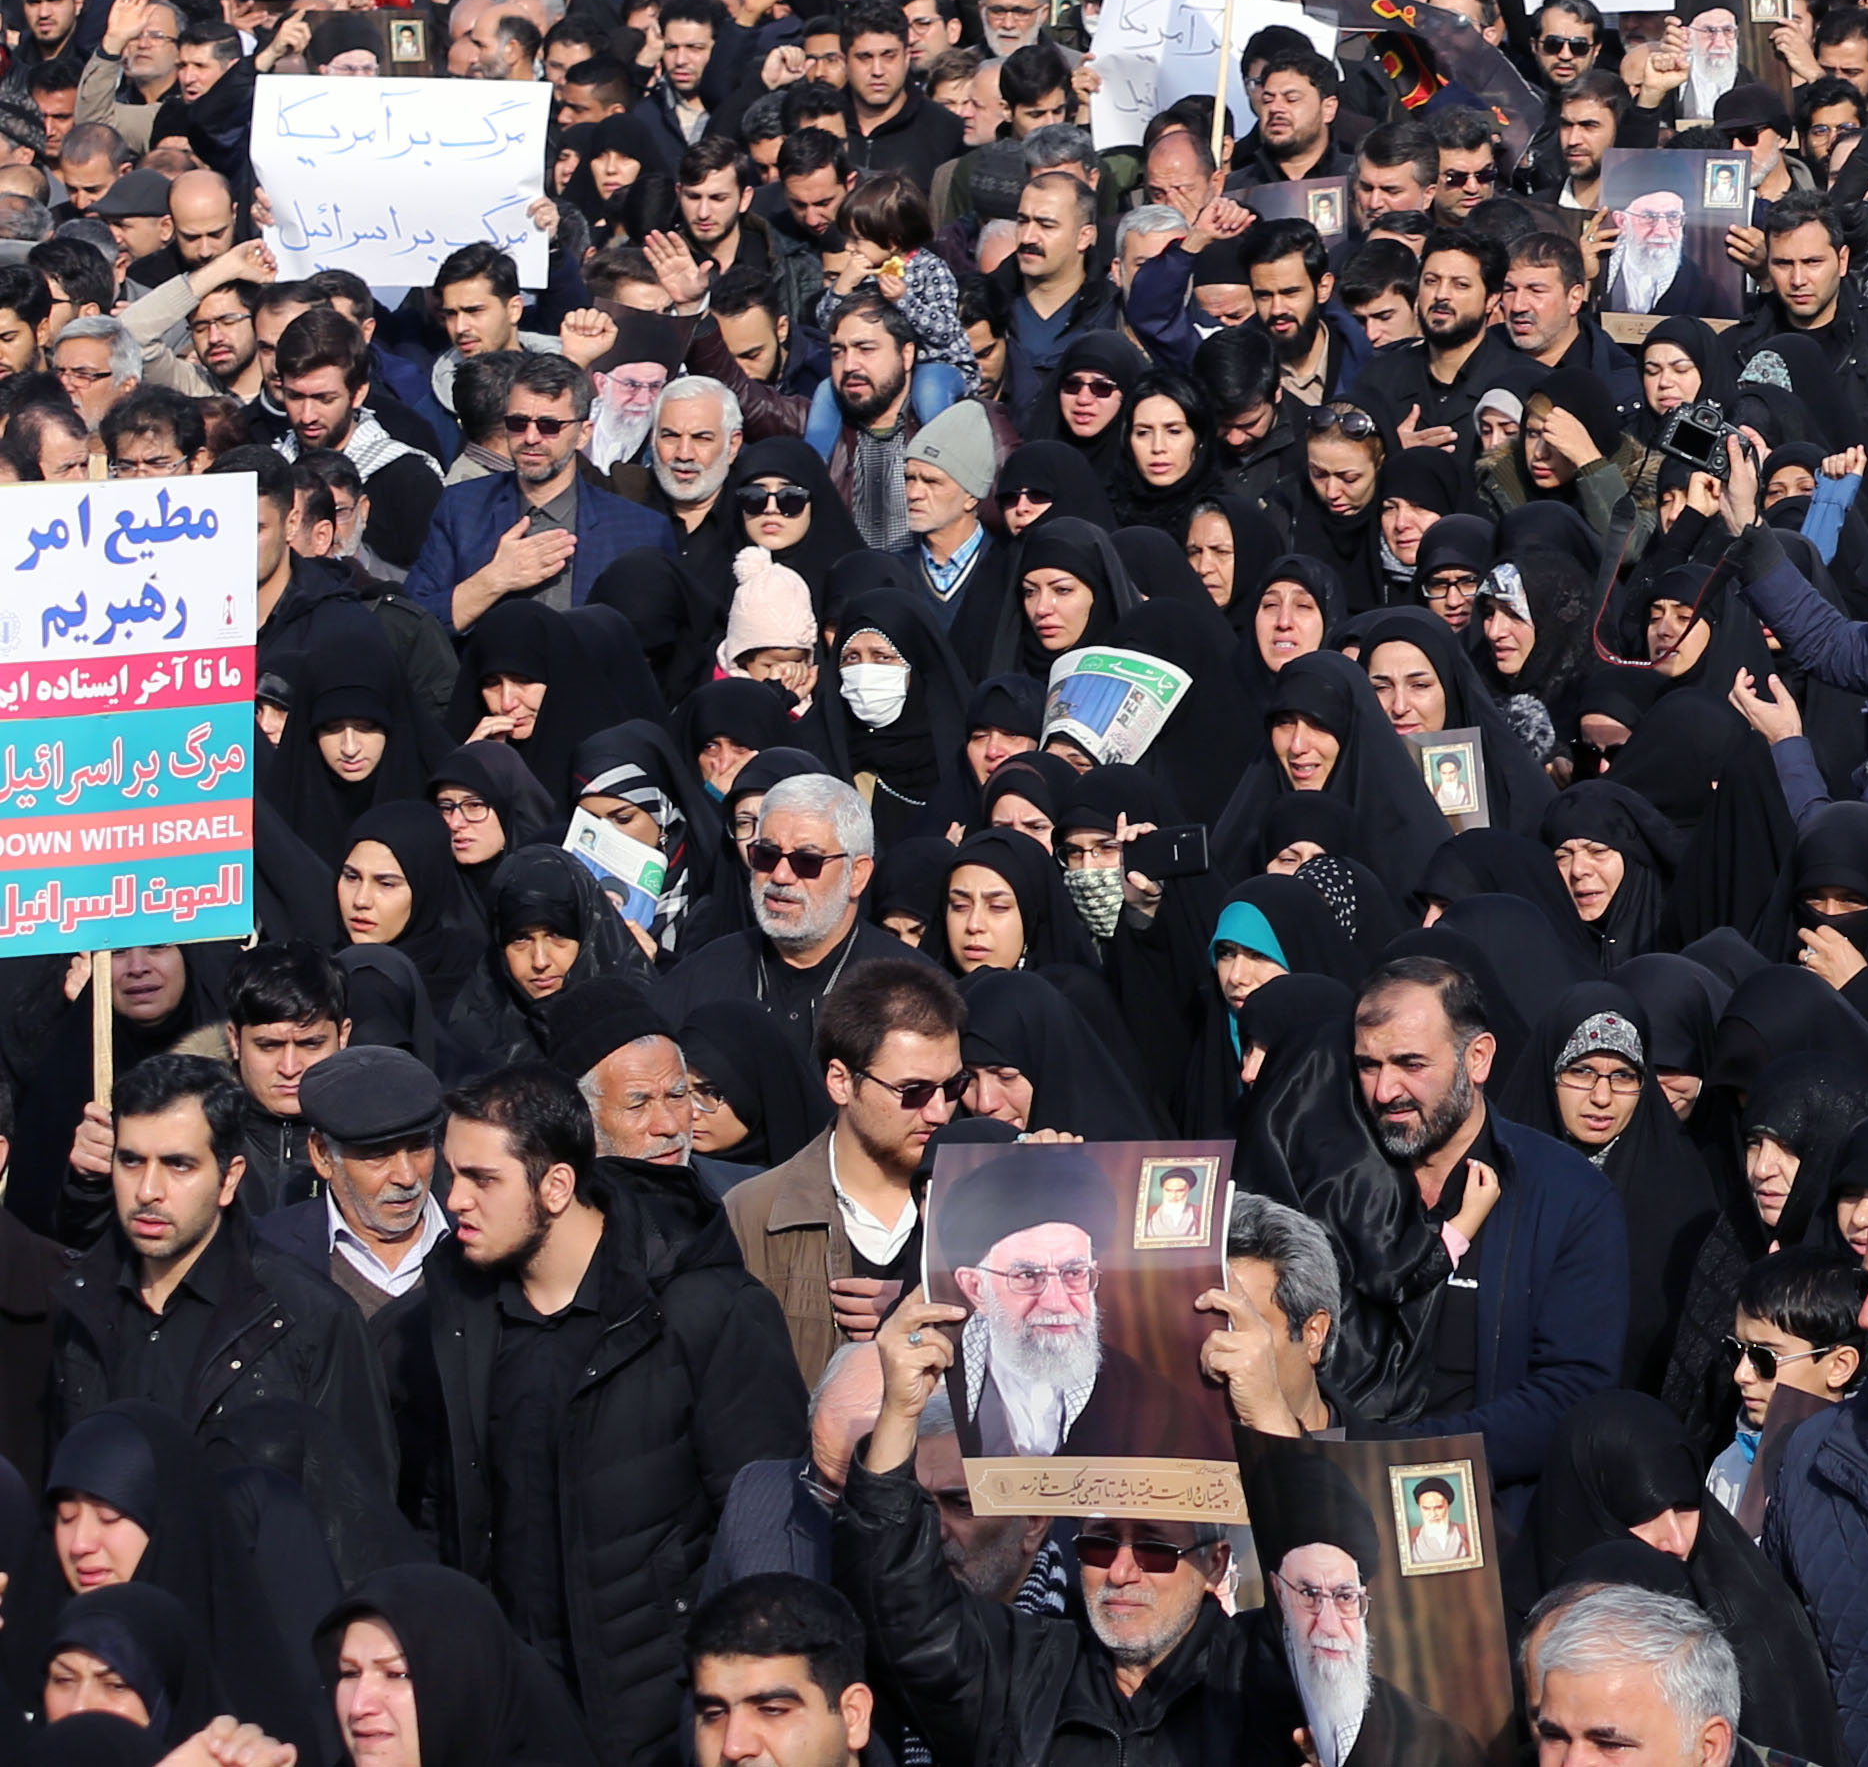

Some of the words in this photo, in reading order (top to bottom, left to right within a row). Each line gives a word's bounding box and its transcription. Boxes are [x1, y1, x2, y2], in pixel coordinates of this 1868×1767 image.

[277, 90, 422, 168] آمریکا
[375, 131, 433, 167] بر
[439, 100, 531, 161] مرگ
[388, 229, 438, 263] بر
[444, 194, 531, 251] مرگ
[14, 493, 91, 571] امر
[104, 486, 220, 565] مطیع
[41, 578, 188, 648] رهبریم
[35, 664, 129, 706] ایستاده
[134, 656, 188, 705] آخر
[193, 657, 213, 690] تا
[219, 656, 242, 688] ما
[121, 751, 161, 799] بر
[168, 721, 246, 790] مرگ
[79, 825, 145, 852] WITH
[152, 815, 243, 845] ISRAEL
[141, 863, 243, 921] الموت
